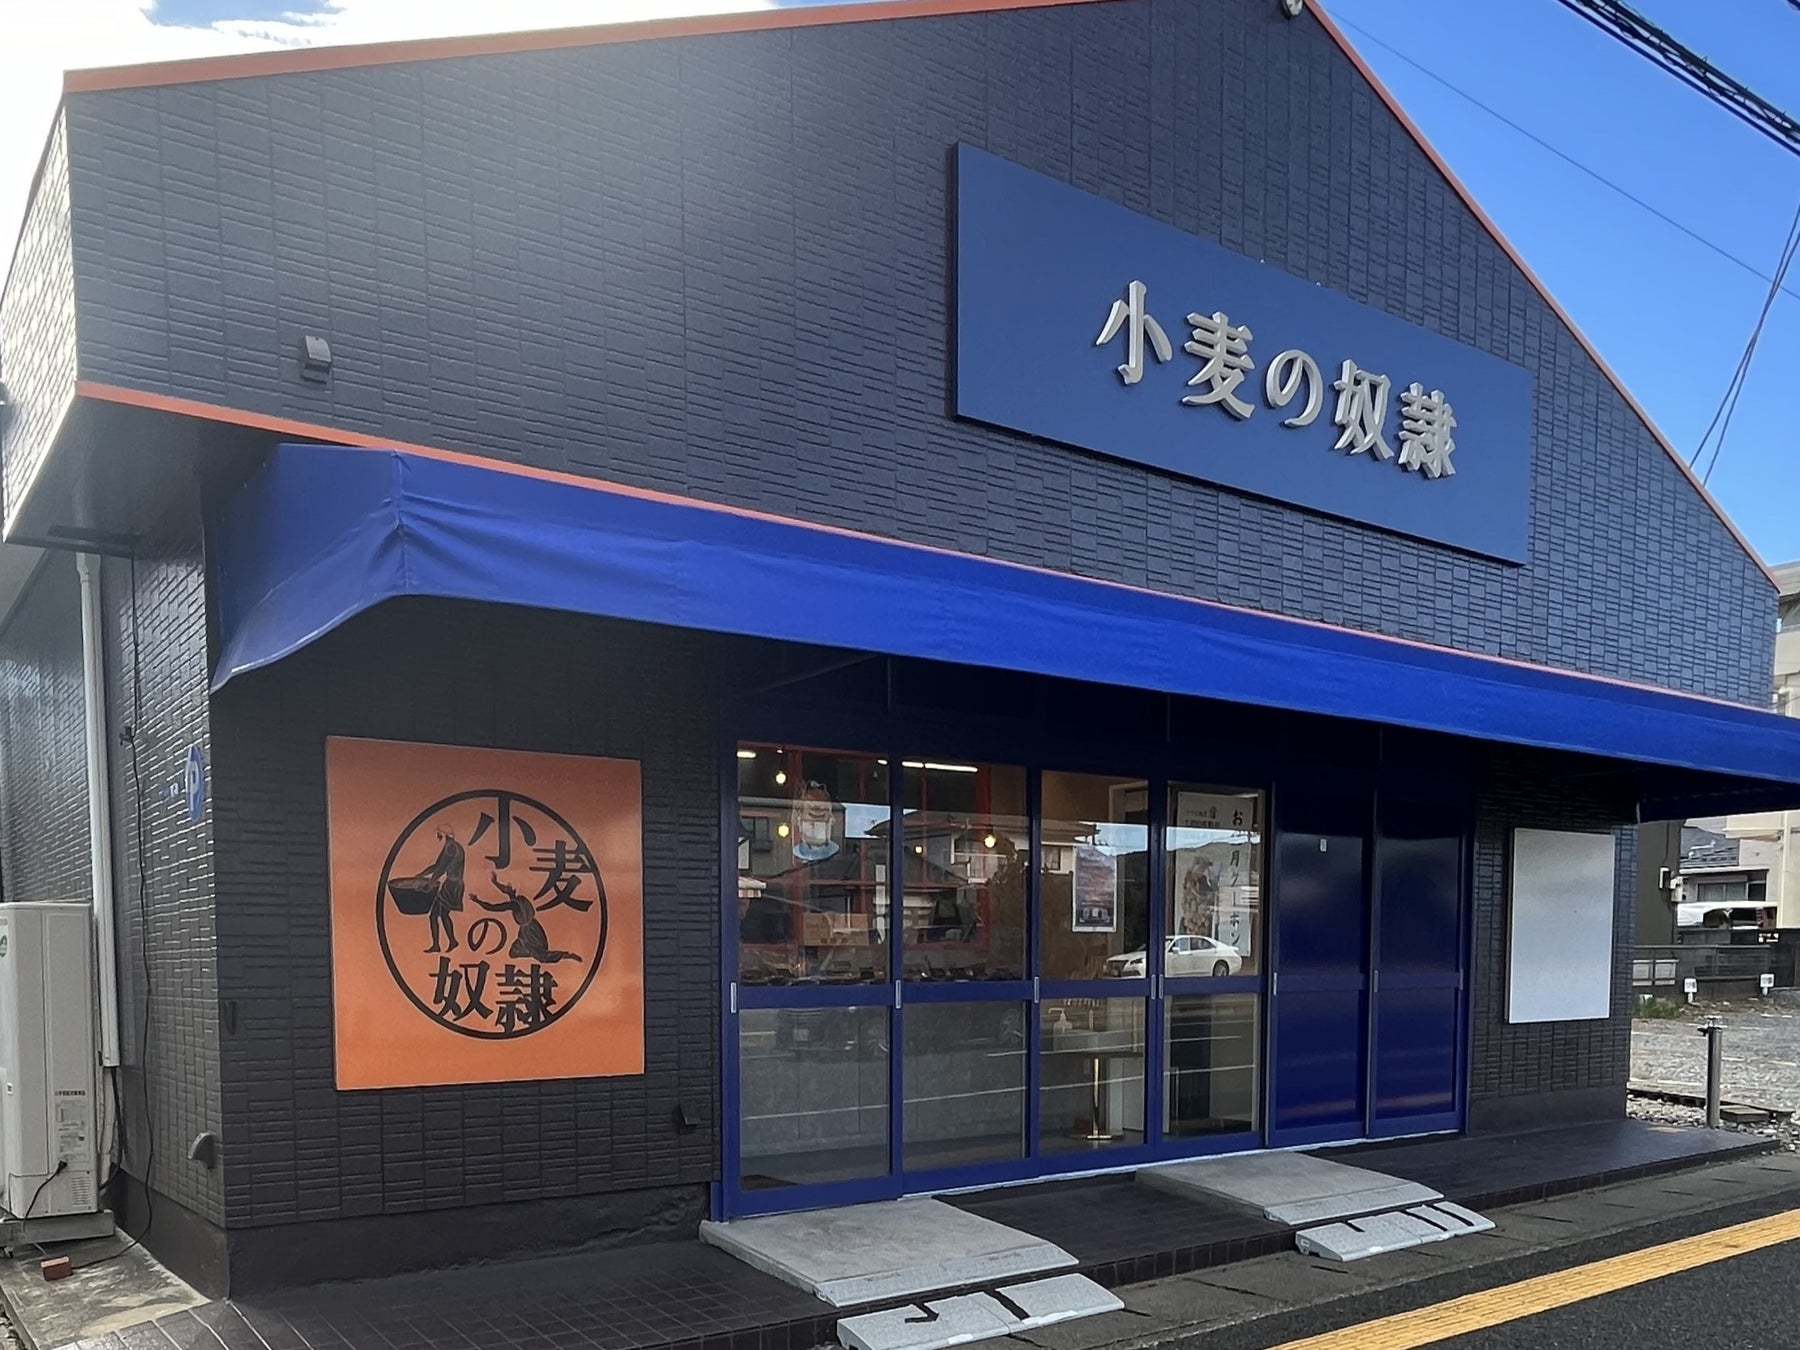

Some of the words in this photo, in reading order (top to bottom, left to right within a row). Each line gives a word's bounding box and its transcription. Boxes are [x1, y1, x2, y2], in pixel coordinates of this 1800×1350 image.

[1095, 280, 1457, 479] 小麦の奴隷
[468, 796, 598, 912] 小麦
[467, 917, 508, 955] の
[429, 956, 559, 1033] 奴隷
